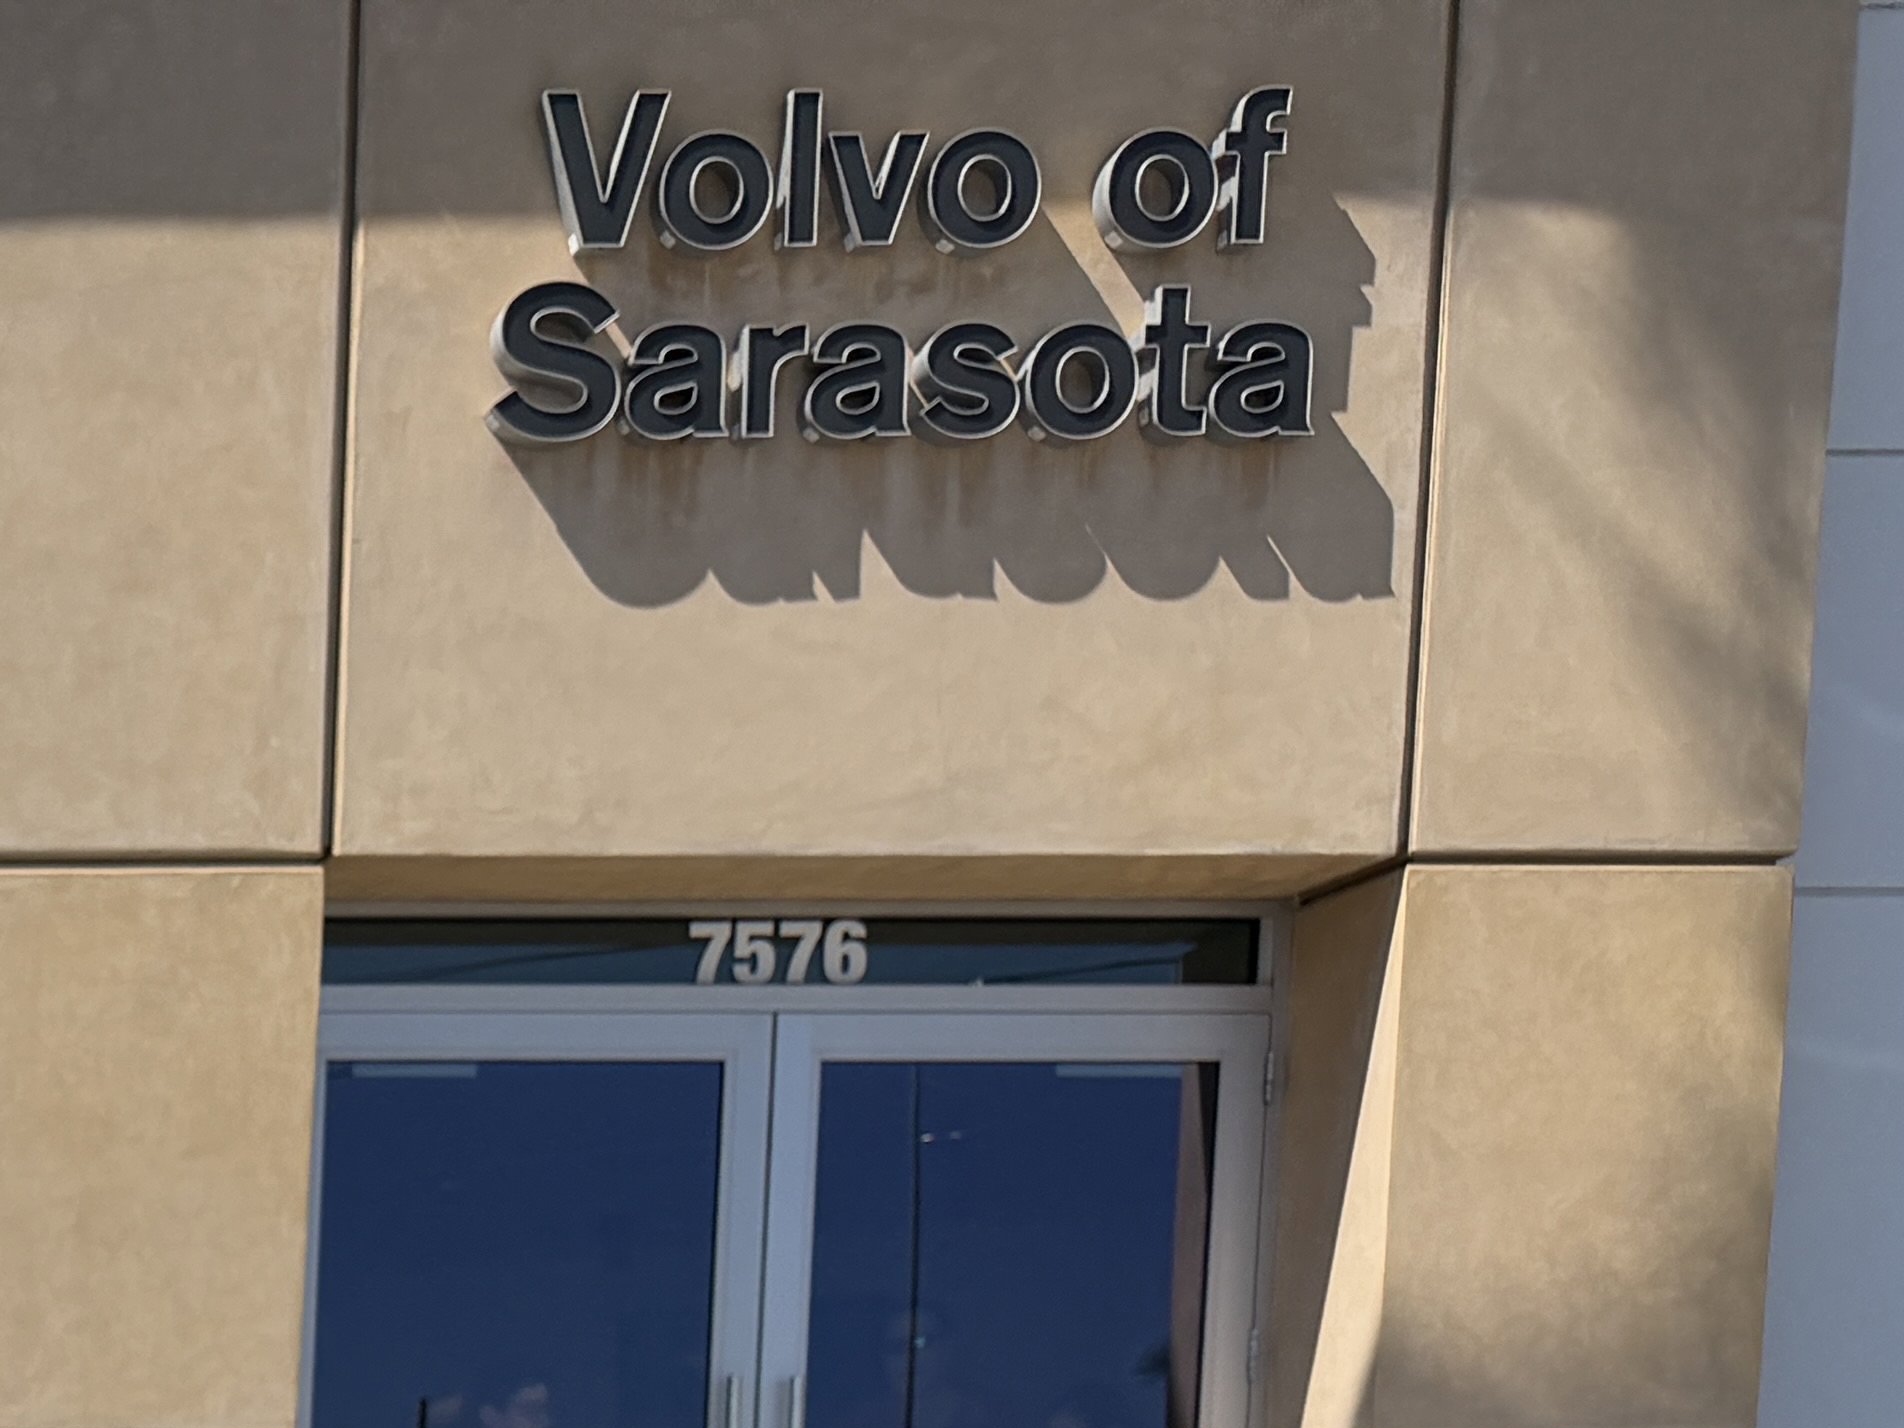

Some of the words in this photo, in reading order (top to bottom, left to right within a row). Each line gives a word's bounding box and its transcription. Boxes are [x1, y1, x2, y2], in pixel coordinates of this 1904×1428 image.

[541, 87, 1042, 255] Volvo
[1091, 83, 1294, 253] of
[486, 279, 1314, 446] Sarasota
[688, 918, 870, 986] 7576
